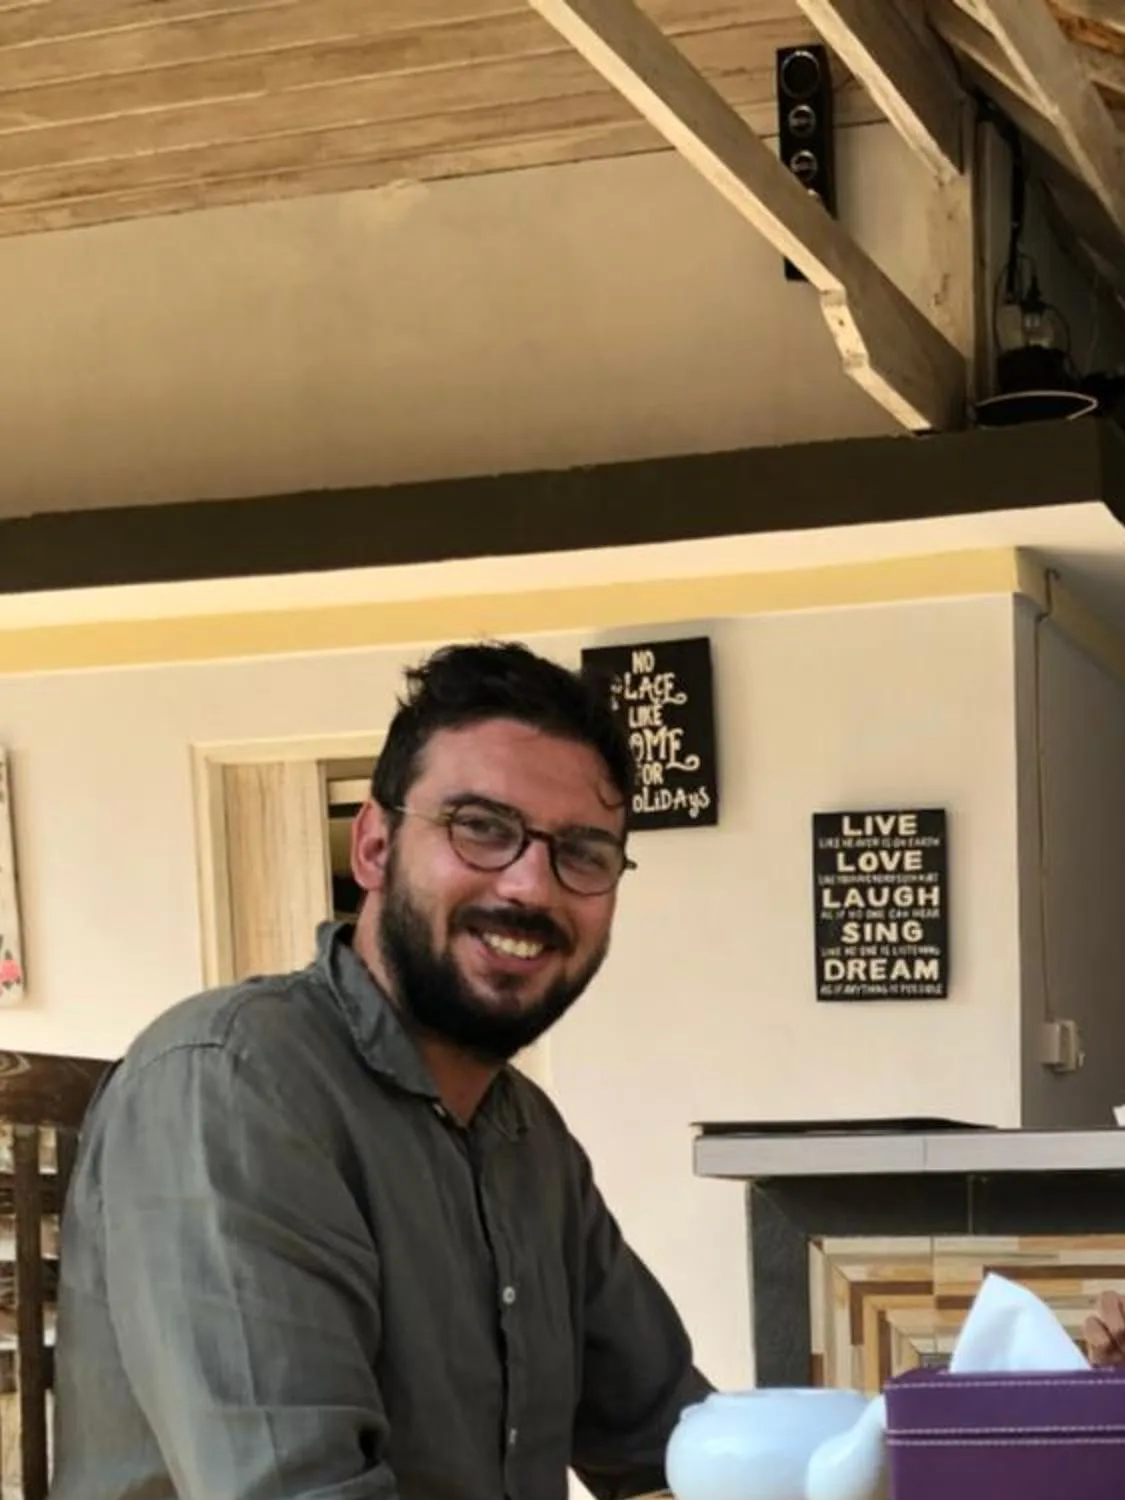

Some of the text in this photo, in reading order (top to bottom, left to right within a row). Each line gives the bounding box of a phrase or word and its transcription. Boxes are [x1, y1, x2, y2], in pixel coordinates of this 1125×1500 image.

[631, 649, 656, 675] NO
[627, 704, 665, 729] LIKE
[628, 724, 701, 771] OME
[631, 785, 711, 819] OLiDAyS
[841, 814, 919, 836] LIVE
[836, 850, 923, 872] LOVE
[822, 886, 940, 908] LAUGH
[841, 920, 924, 944] SING
[823, 959, 940, 981] DREAM
